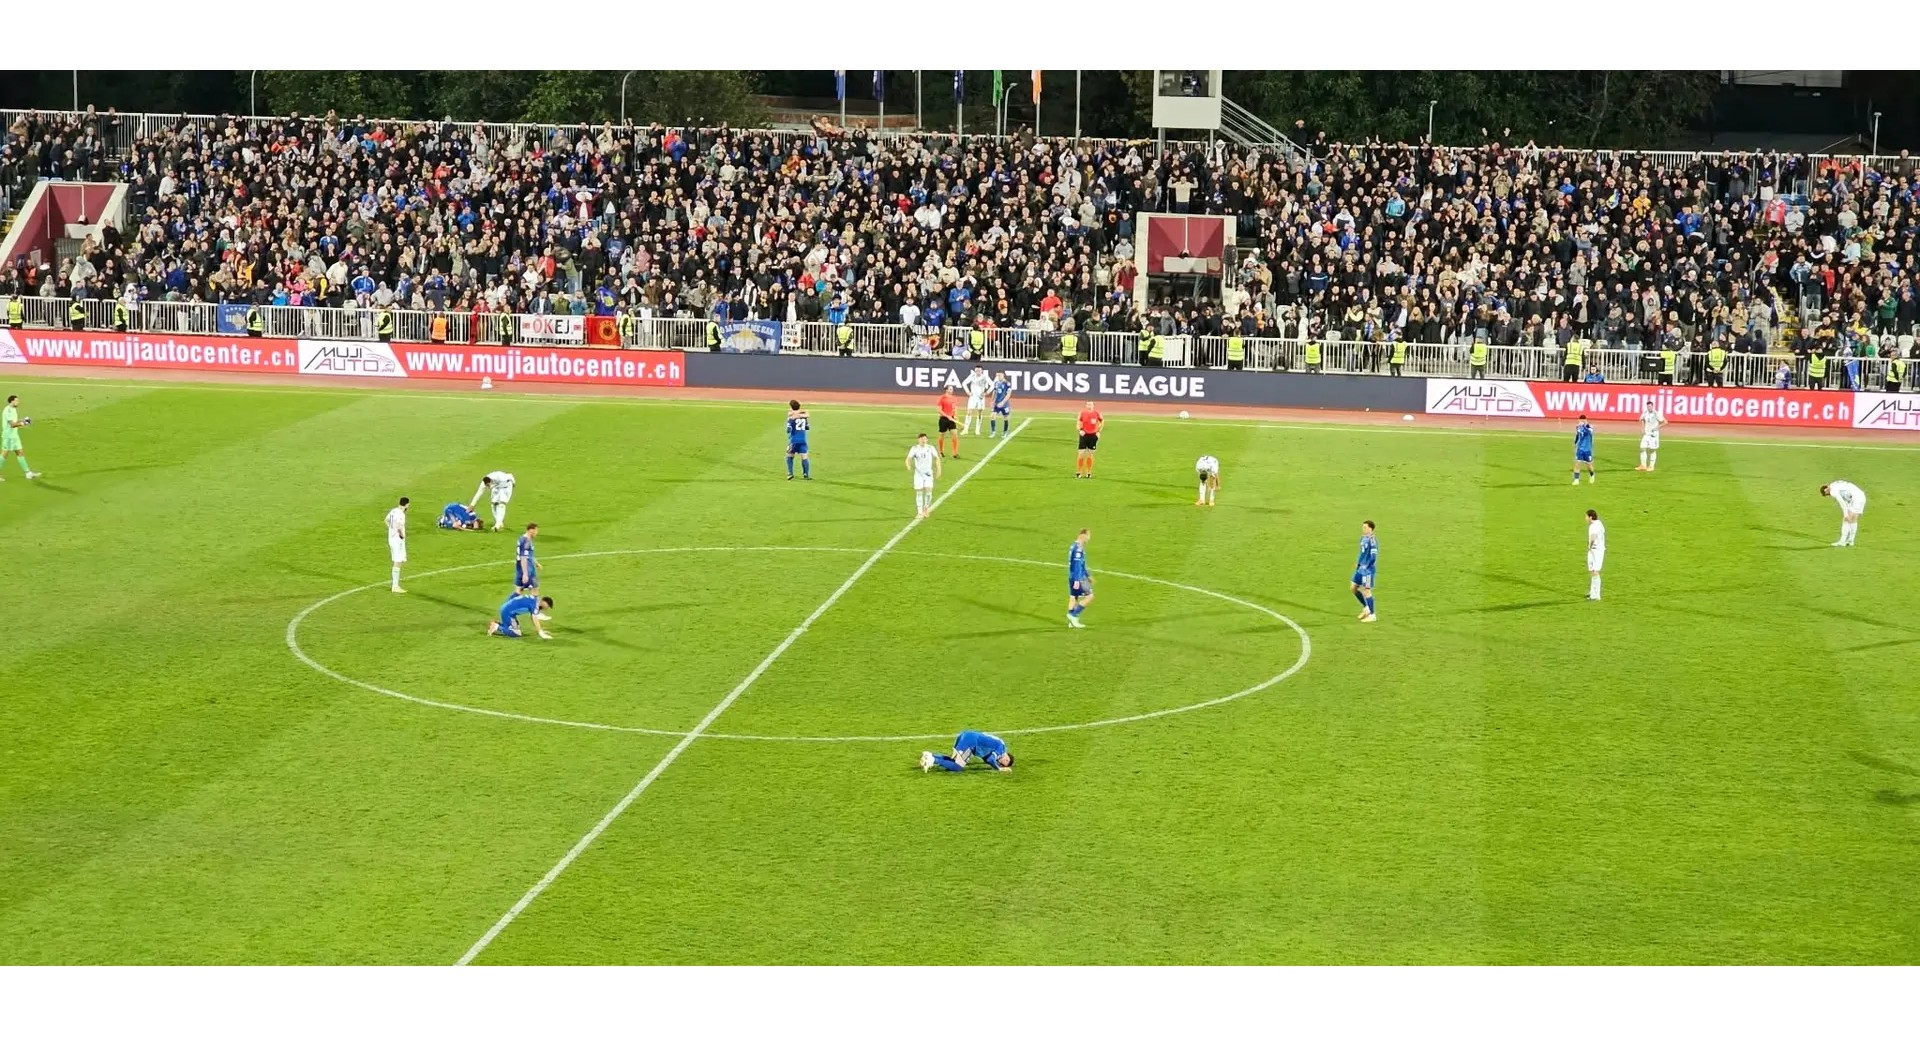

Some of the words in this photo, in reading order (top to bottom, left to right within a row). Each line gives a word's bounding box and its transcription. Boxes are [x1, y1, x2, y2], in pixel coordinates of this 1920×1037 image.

[25, 336, 295, 367] www.mujiautocenter.ch
[304, 347, 362, 369] MUJI
[405, 349, 680, 379] www.mujiautocenter.ch
[315, 358, 379, 372] AUTO
[895, 366, 963, 389] UEFA
[970, 368, 1090, 393] TIONS
[1099, 373, 1205, 398] LEAGUE
[1431, 385, 1497, 410] MUJI
[1443, 397, 1514, 412] AUTO
